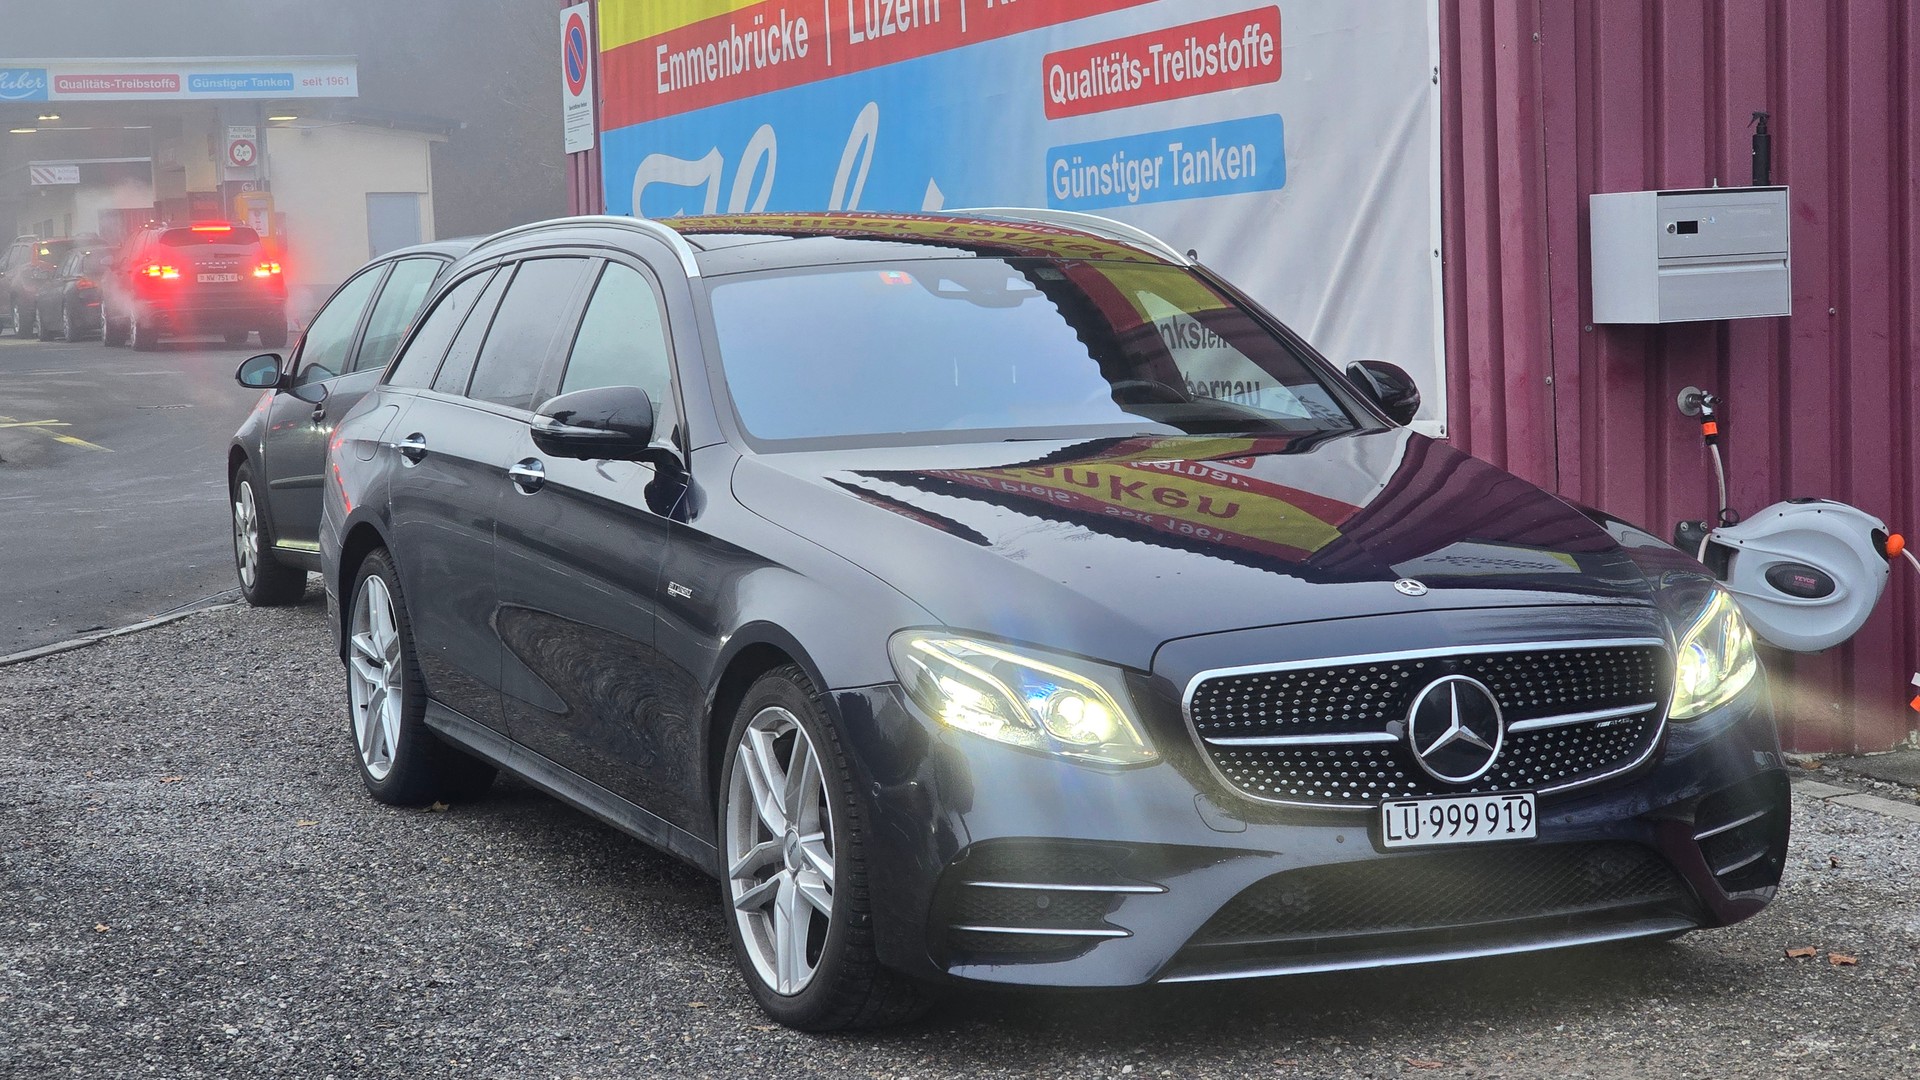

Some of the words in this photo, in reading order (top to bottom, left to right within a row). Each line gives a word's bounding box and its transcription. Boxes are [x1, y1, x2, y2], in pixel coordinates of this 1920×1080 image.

[656, 14, 809, 94] Emmenbrücke
[848, 0, 940, 45] Luzern
[1048, 23, 1274, 105] Qualitäts-Treibstoffe
[59, 78, 176, 90] Qualitäts-Treibstoffe
[192, 78, 249, 90] Günstiger
[251, 77, 290, 88] Tanken
[302, 77, 322, 87] seit
[326, 76, 349, 86] 1961
[1052, 149, 1162, 202] Günstiger
[1168, 138, 1256, 185] Tanken
